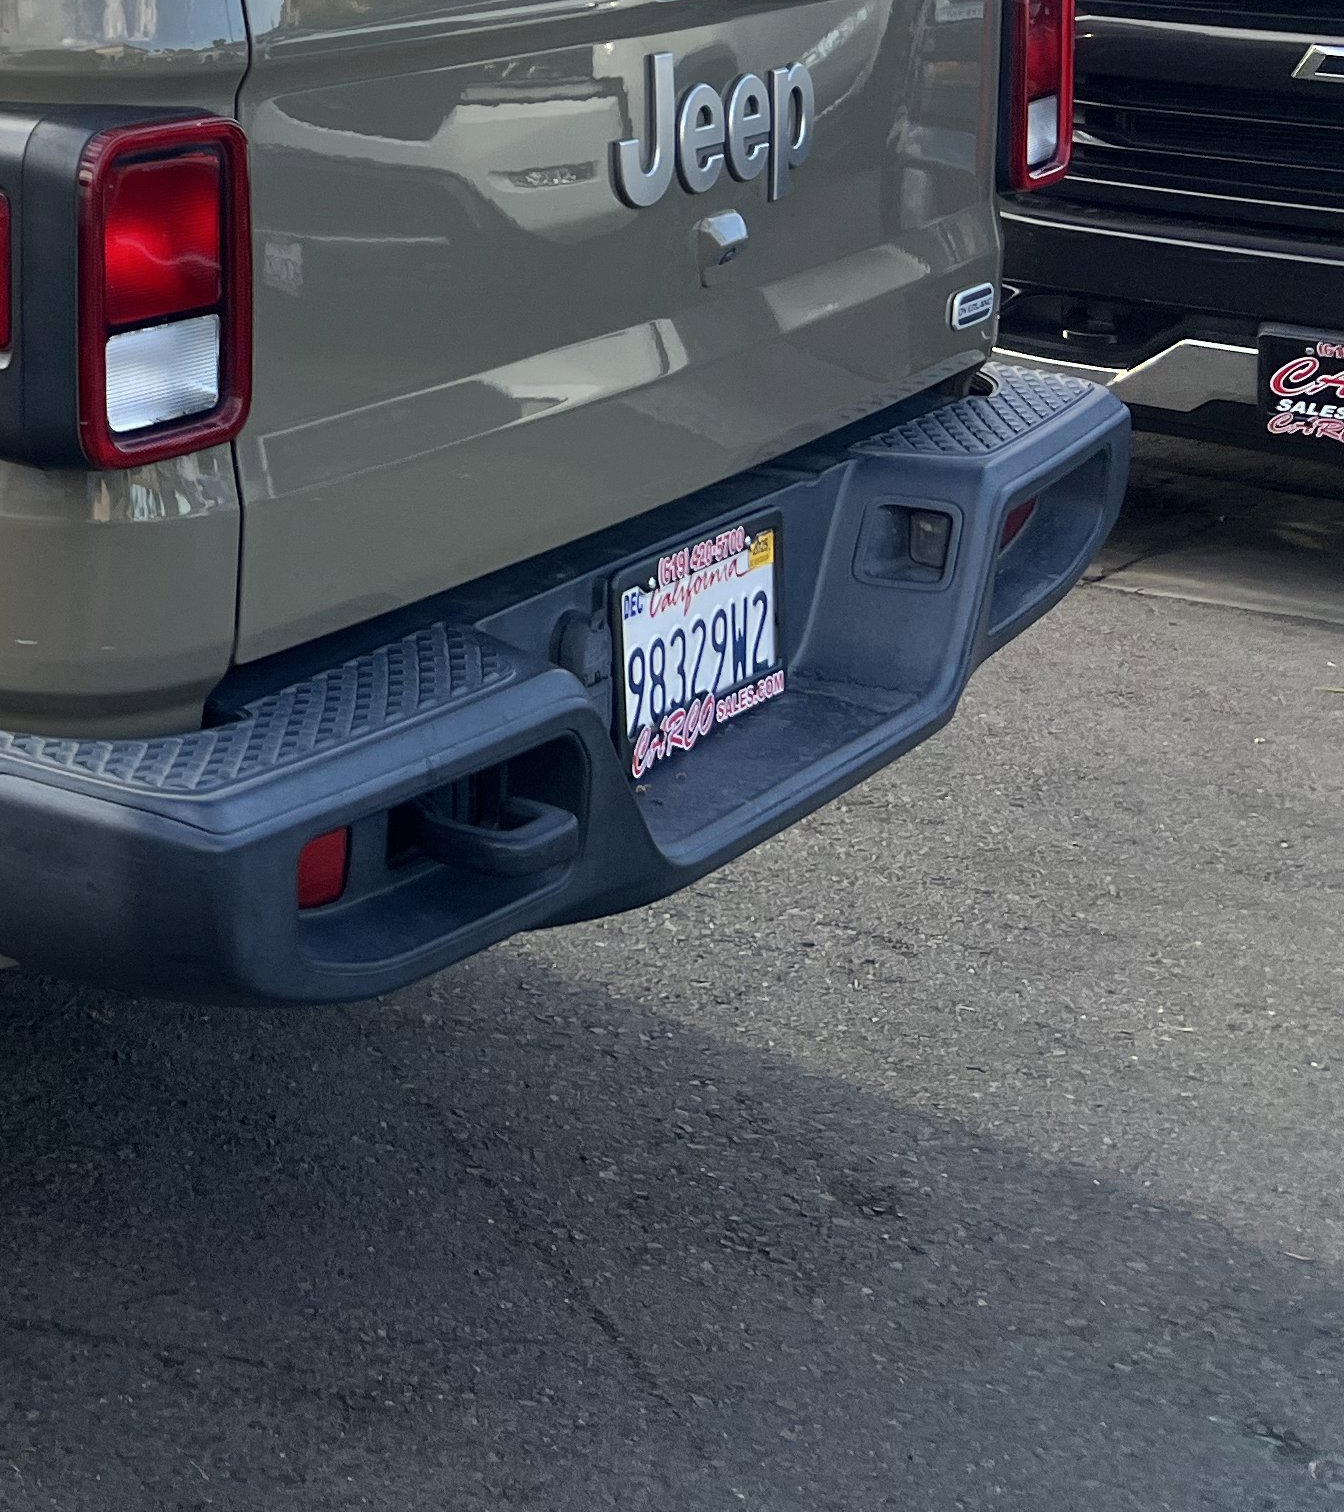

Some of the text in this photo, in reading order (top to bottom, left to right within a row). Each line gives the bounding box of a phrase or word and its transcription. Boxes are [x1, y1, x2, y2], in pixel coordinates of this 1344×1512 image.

[608, 51, 814, 210] Jeep
[623, 591, 643, 620] DEC
[649, 557, 753, 618] California
[658, 525, 745, 588] (619) 420-5700
[627, 589, 769, 739] 98329W2
[631, 669, 785, 779] CARCO SALES.COM
